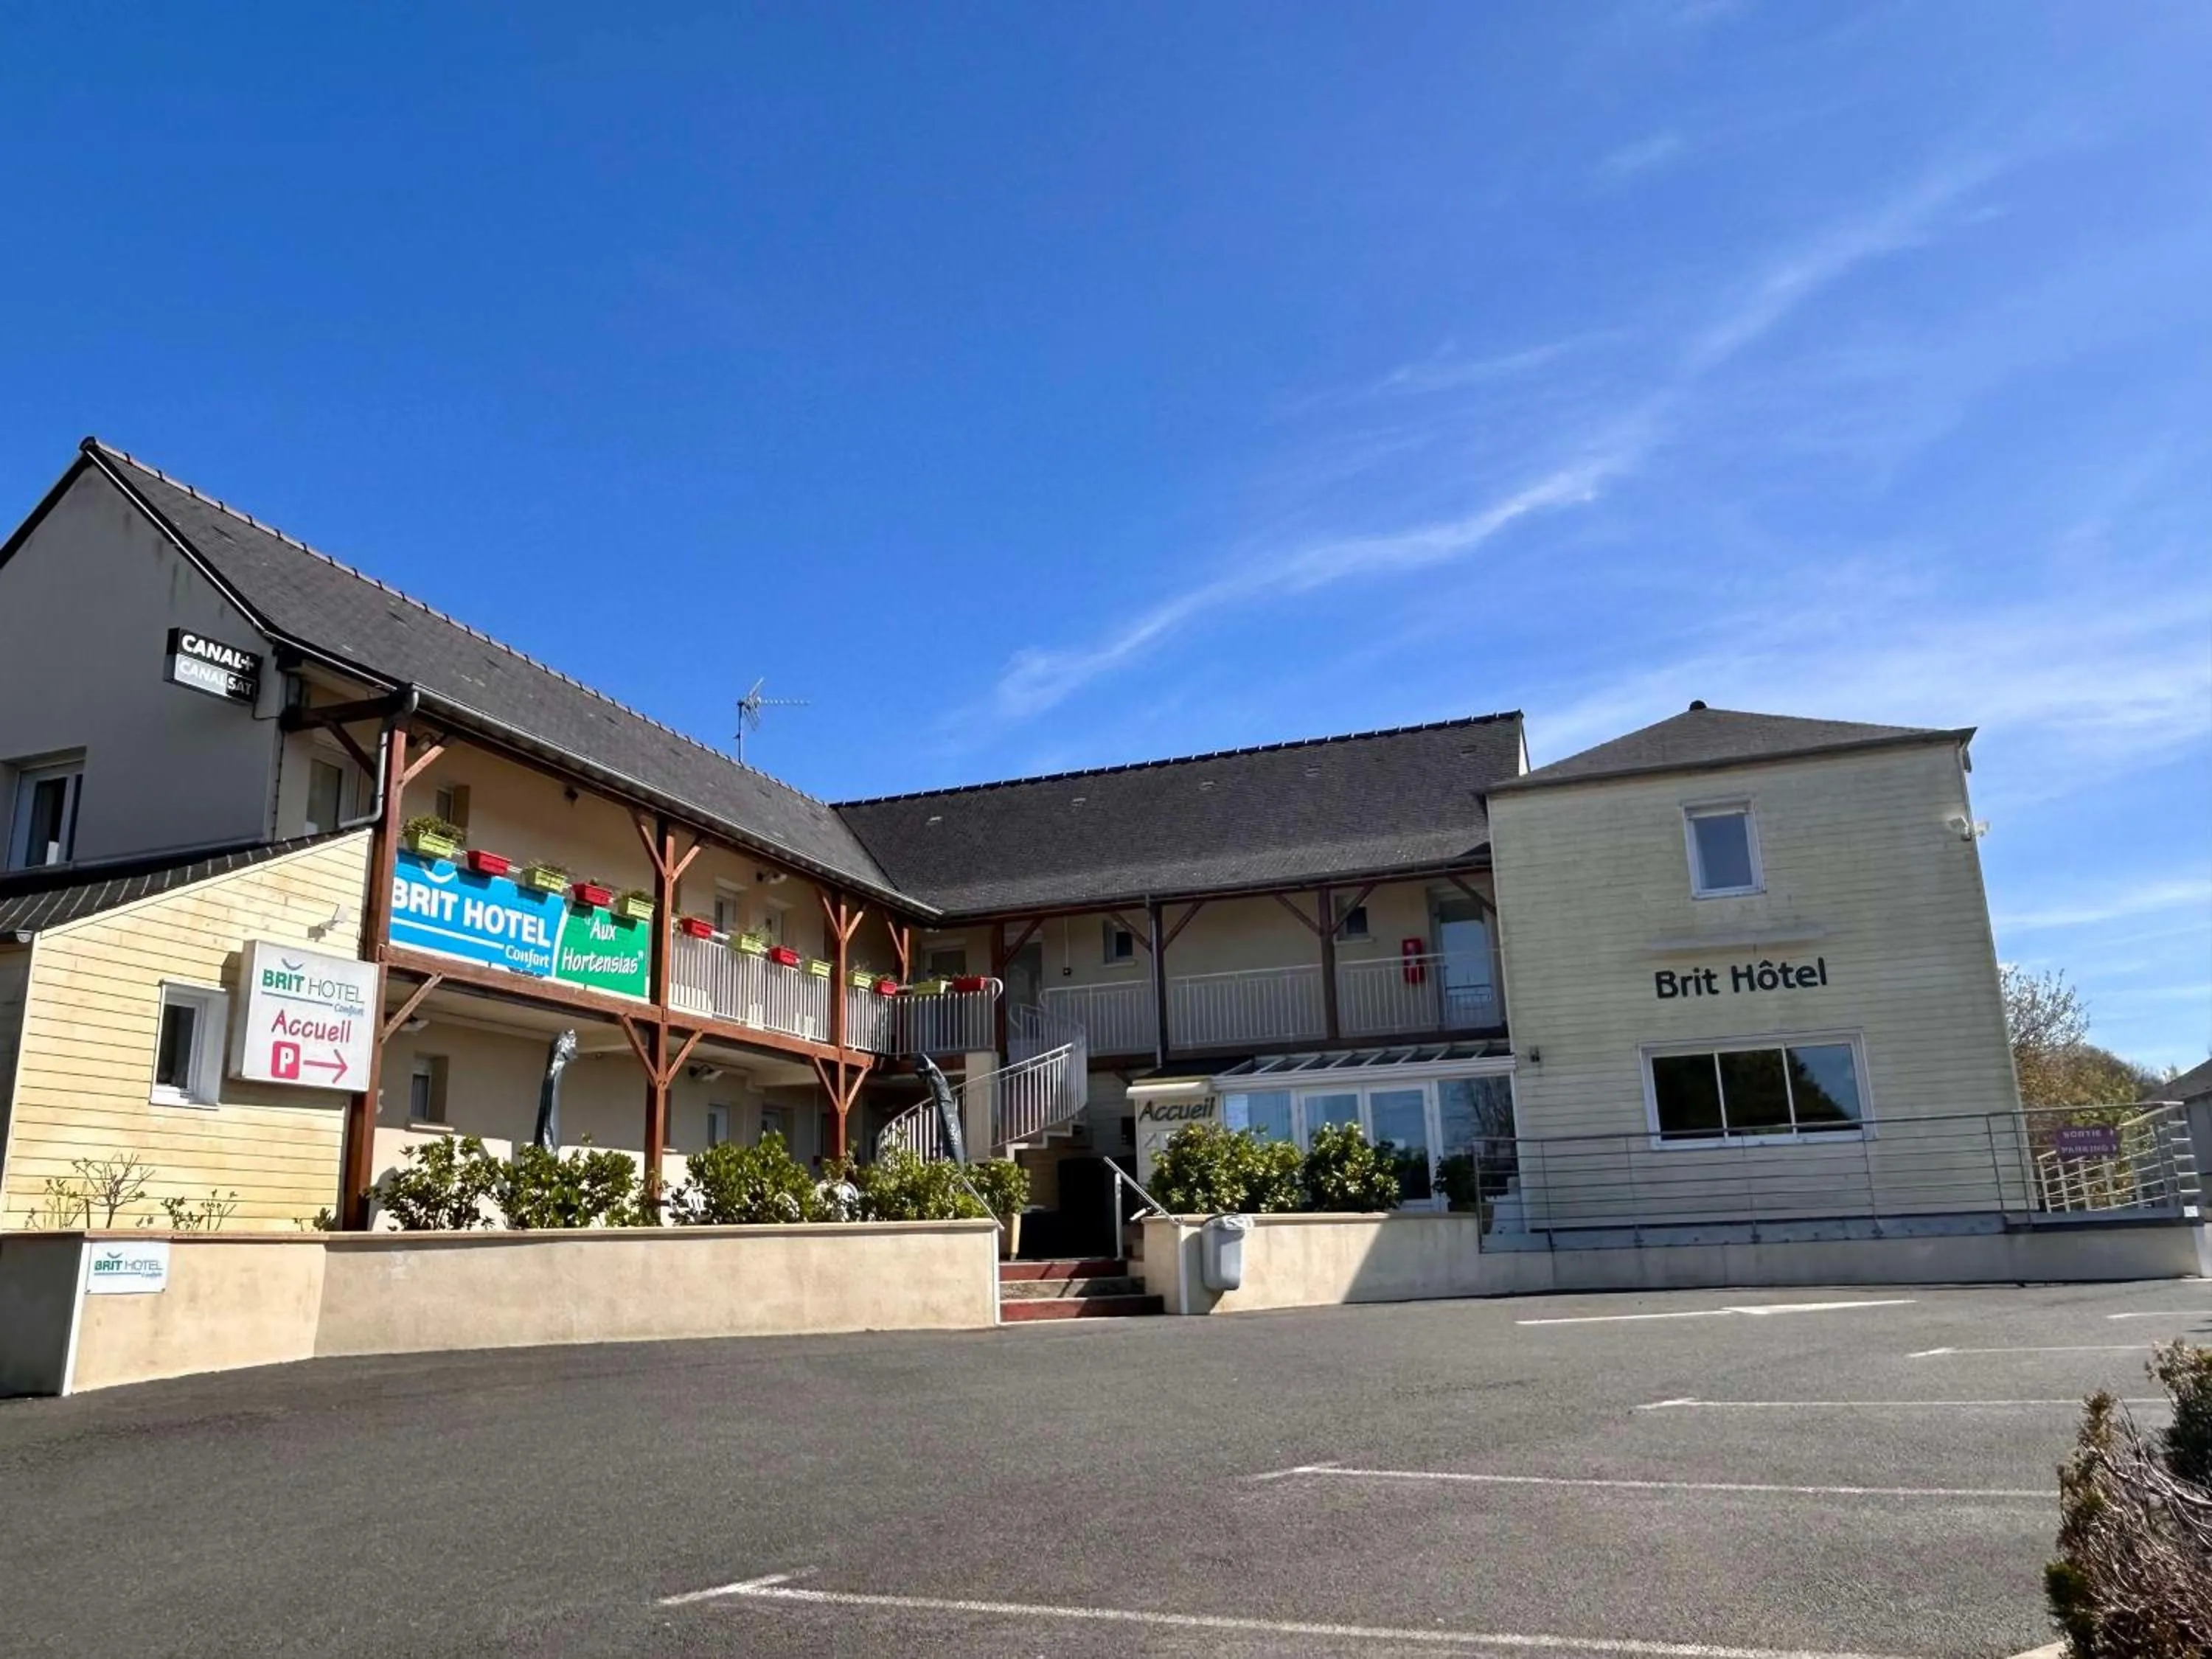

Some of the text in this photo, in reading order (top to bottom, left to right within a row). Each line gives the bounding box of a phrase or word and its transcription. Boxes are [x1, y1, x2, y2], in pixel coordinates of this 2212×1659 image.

[182, 635, 254, 671] CANAL+
[391, 877, 551, 948] BRIT HOTEL
[504, 945, 550, 969] Confort
[262, 969, 364, 1004] BRIT HOTEL
[1655, 957, 1827, 998] Brit Hôtel
[271, 1009, 352, 1043] Accueil
[334, 1003, 365, 1017] Confort
[1138, 1096, 1216, 1124] Accueil
[94, 1259, 164, 1271] BRIT HOTEL
